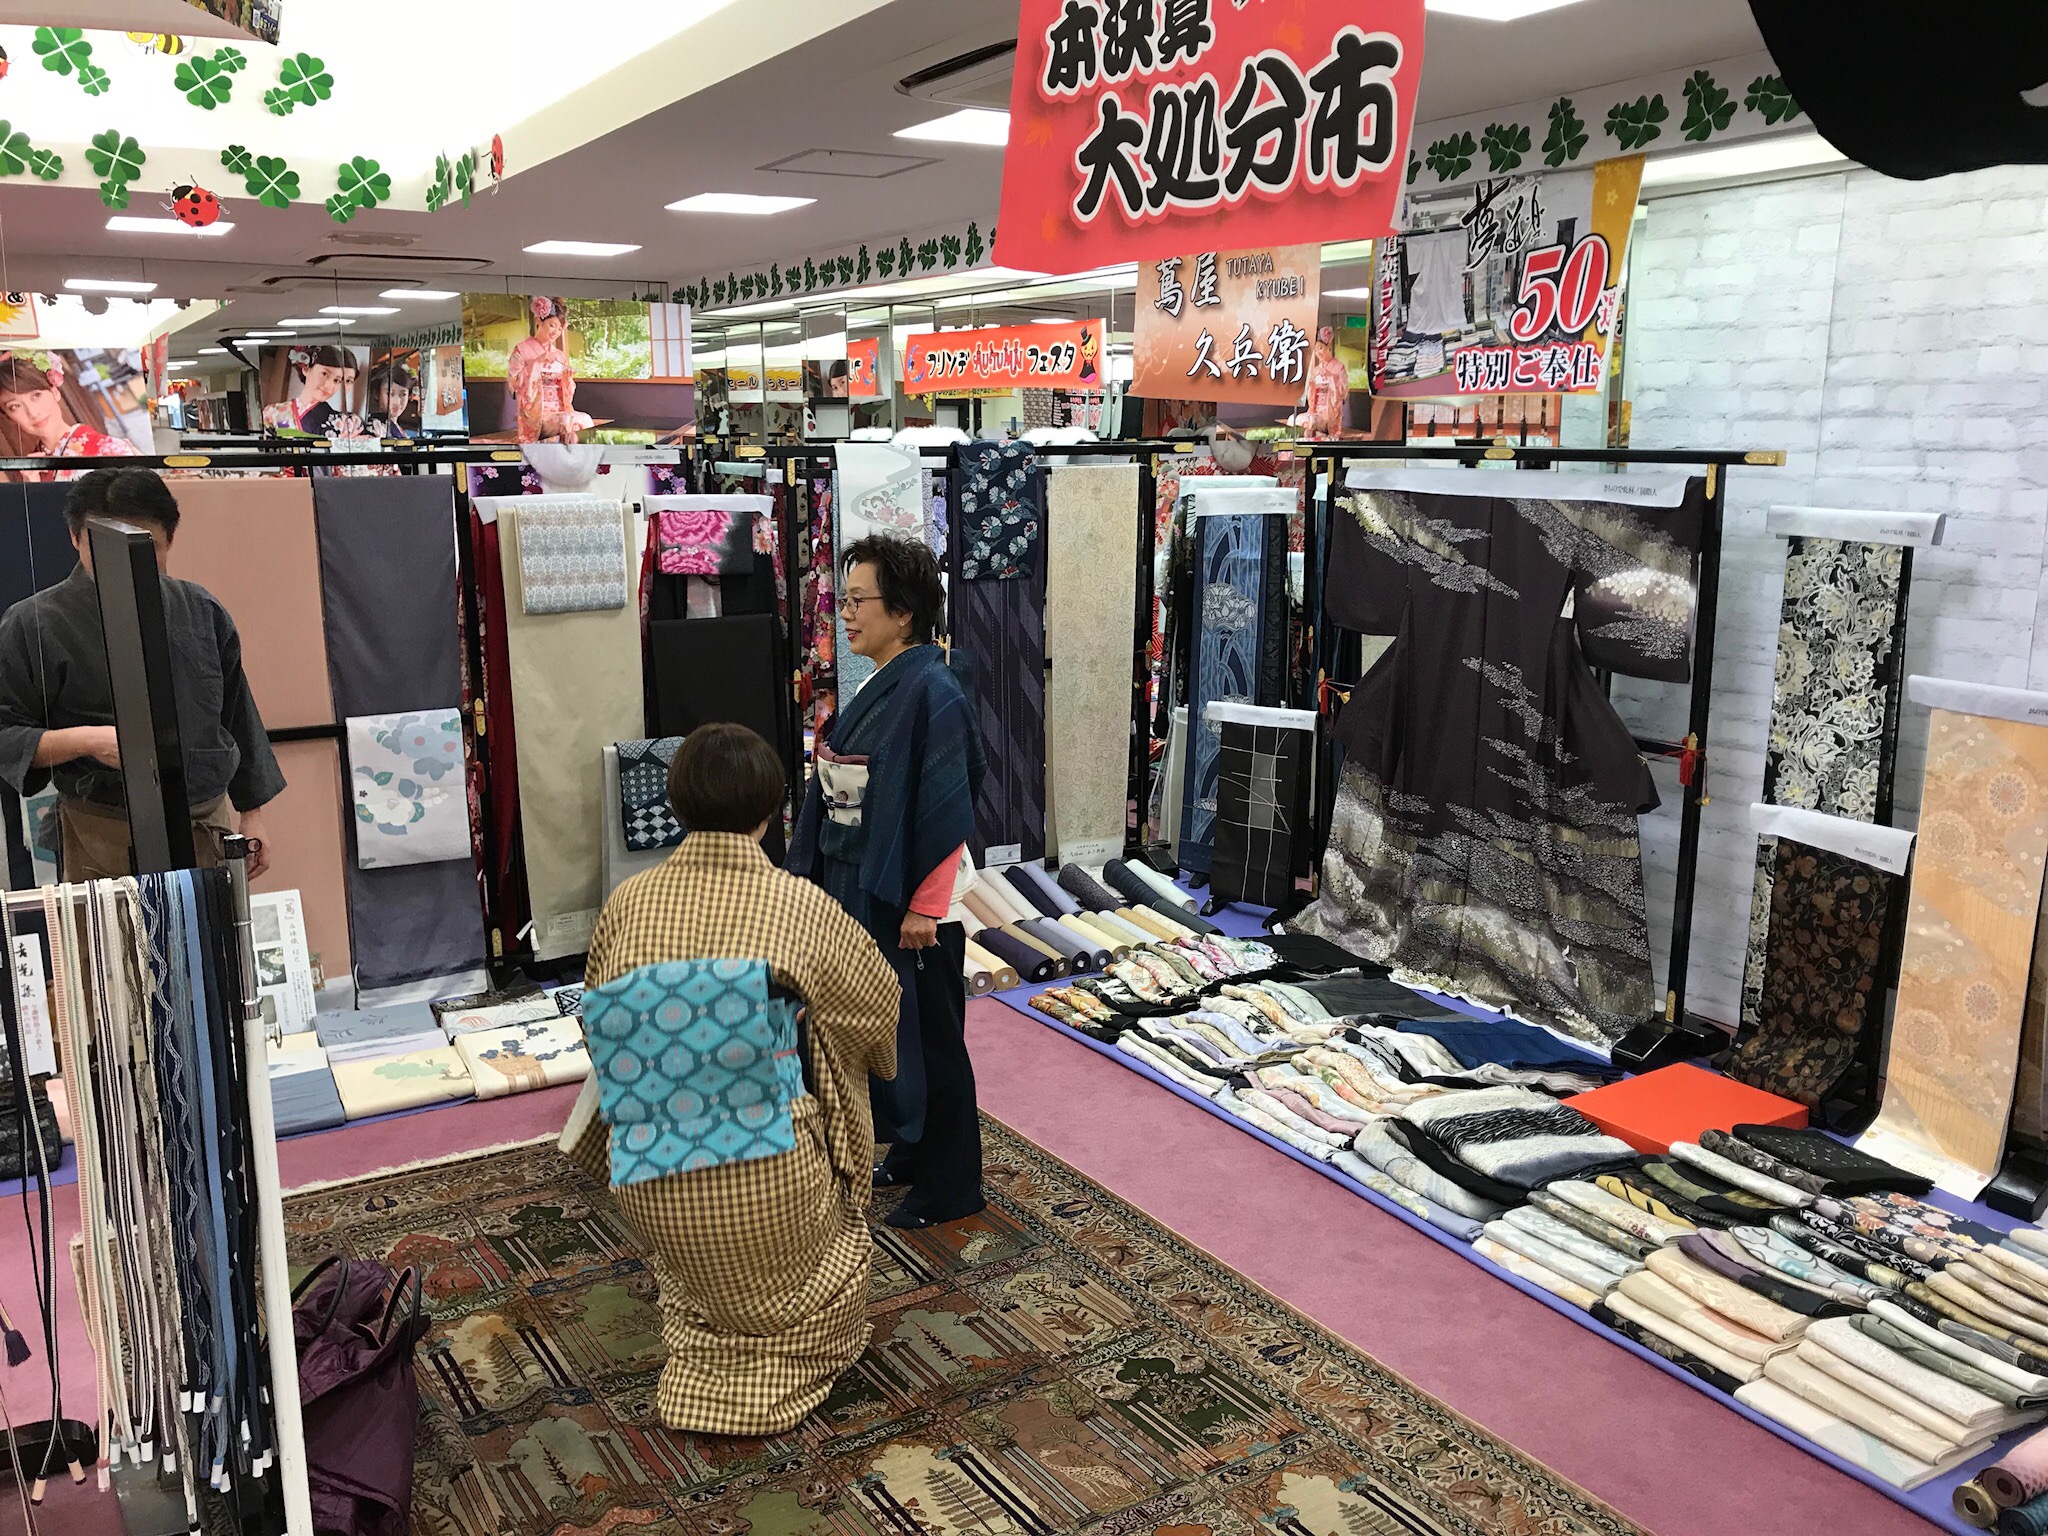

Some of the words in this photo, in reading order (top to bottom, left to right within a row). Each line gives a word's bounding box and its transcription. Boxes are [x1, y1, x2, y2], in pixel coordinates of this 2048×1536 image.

[1045, 0, 1213, 91] 本決算
[1075, 32, 1400, 217] 大処分市
[1226, 253, 1274, 277] TUTAYA
[1256, 275, 1305, 300] KYUBEI
[1186, 318, 1310, 385] 久兵衛
[1457, 347, 1601, 391] 特別ご奉仕
